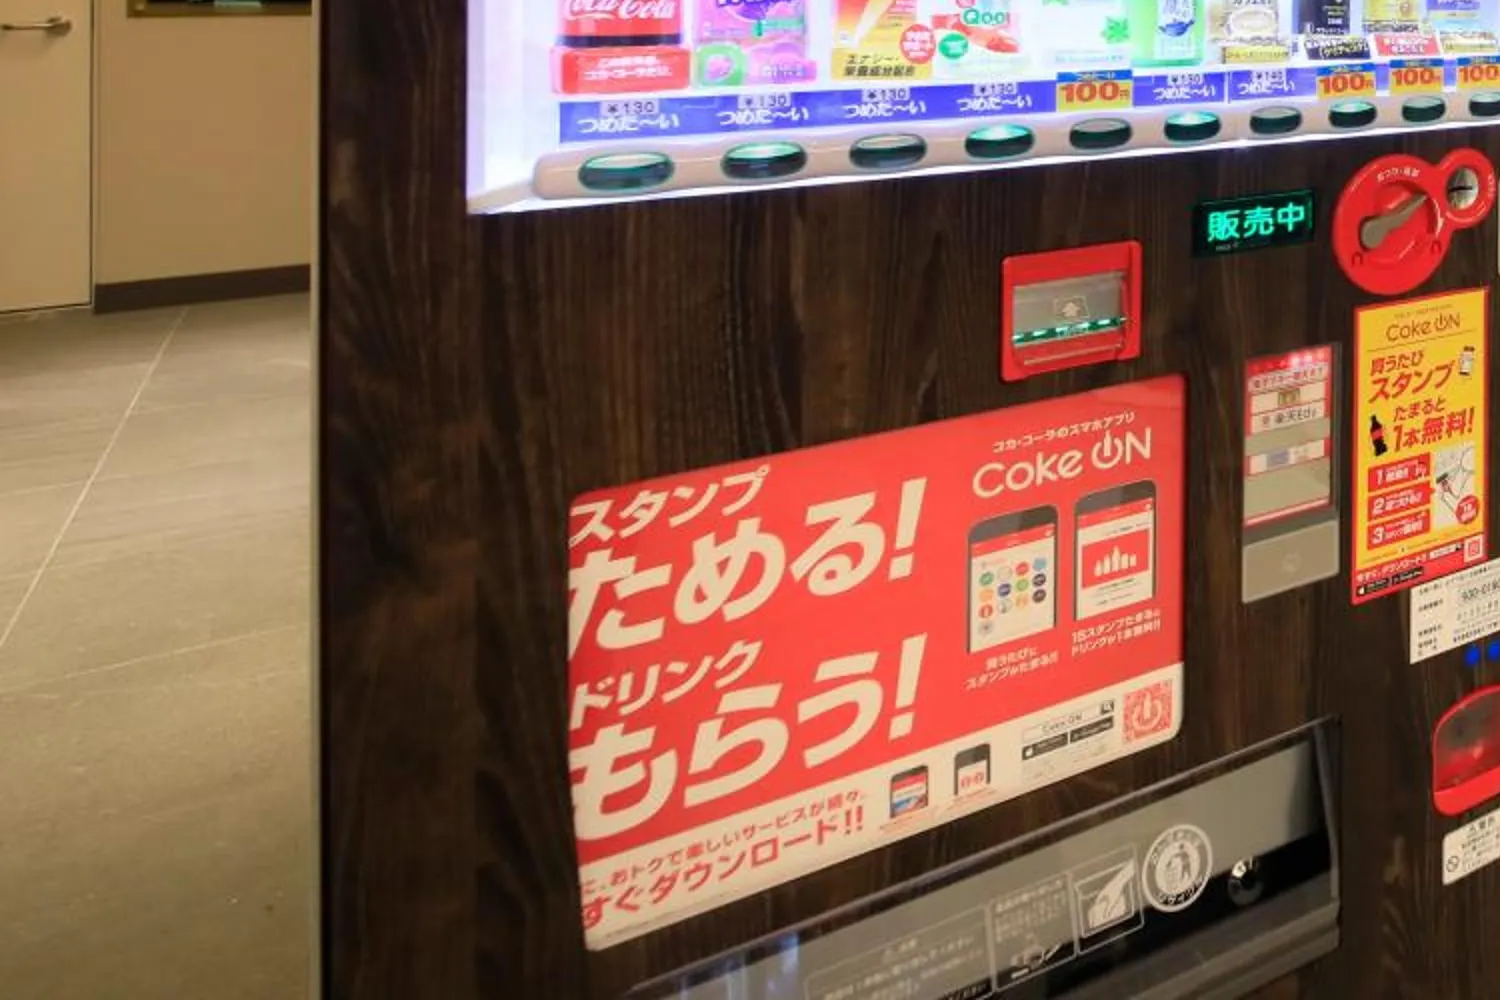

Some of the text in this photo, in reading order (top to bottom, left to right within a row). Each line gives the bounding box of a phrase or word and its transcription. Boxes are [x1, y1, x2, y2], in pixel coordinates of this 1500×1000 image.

[963, 8, 1006, 25] Qoo
[1208, 202, 1305, 242] 販売中
[1386, 317, 1432, 343] Coke
[1367, 359, 1456, 404] スタンプ
[1370, 350, 1424, 377] 買うたび
[1393, 396, 1447, 423] たまると
[972, 427, 1152, 498] Coke ON
[569, 464, 770, 548] スタンプ
[568, 477, 928, 661] ためる!
[569, 639, 763, 731] ドリンク
[568, 632, 928, 842] もらう!
